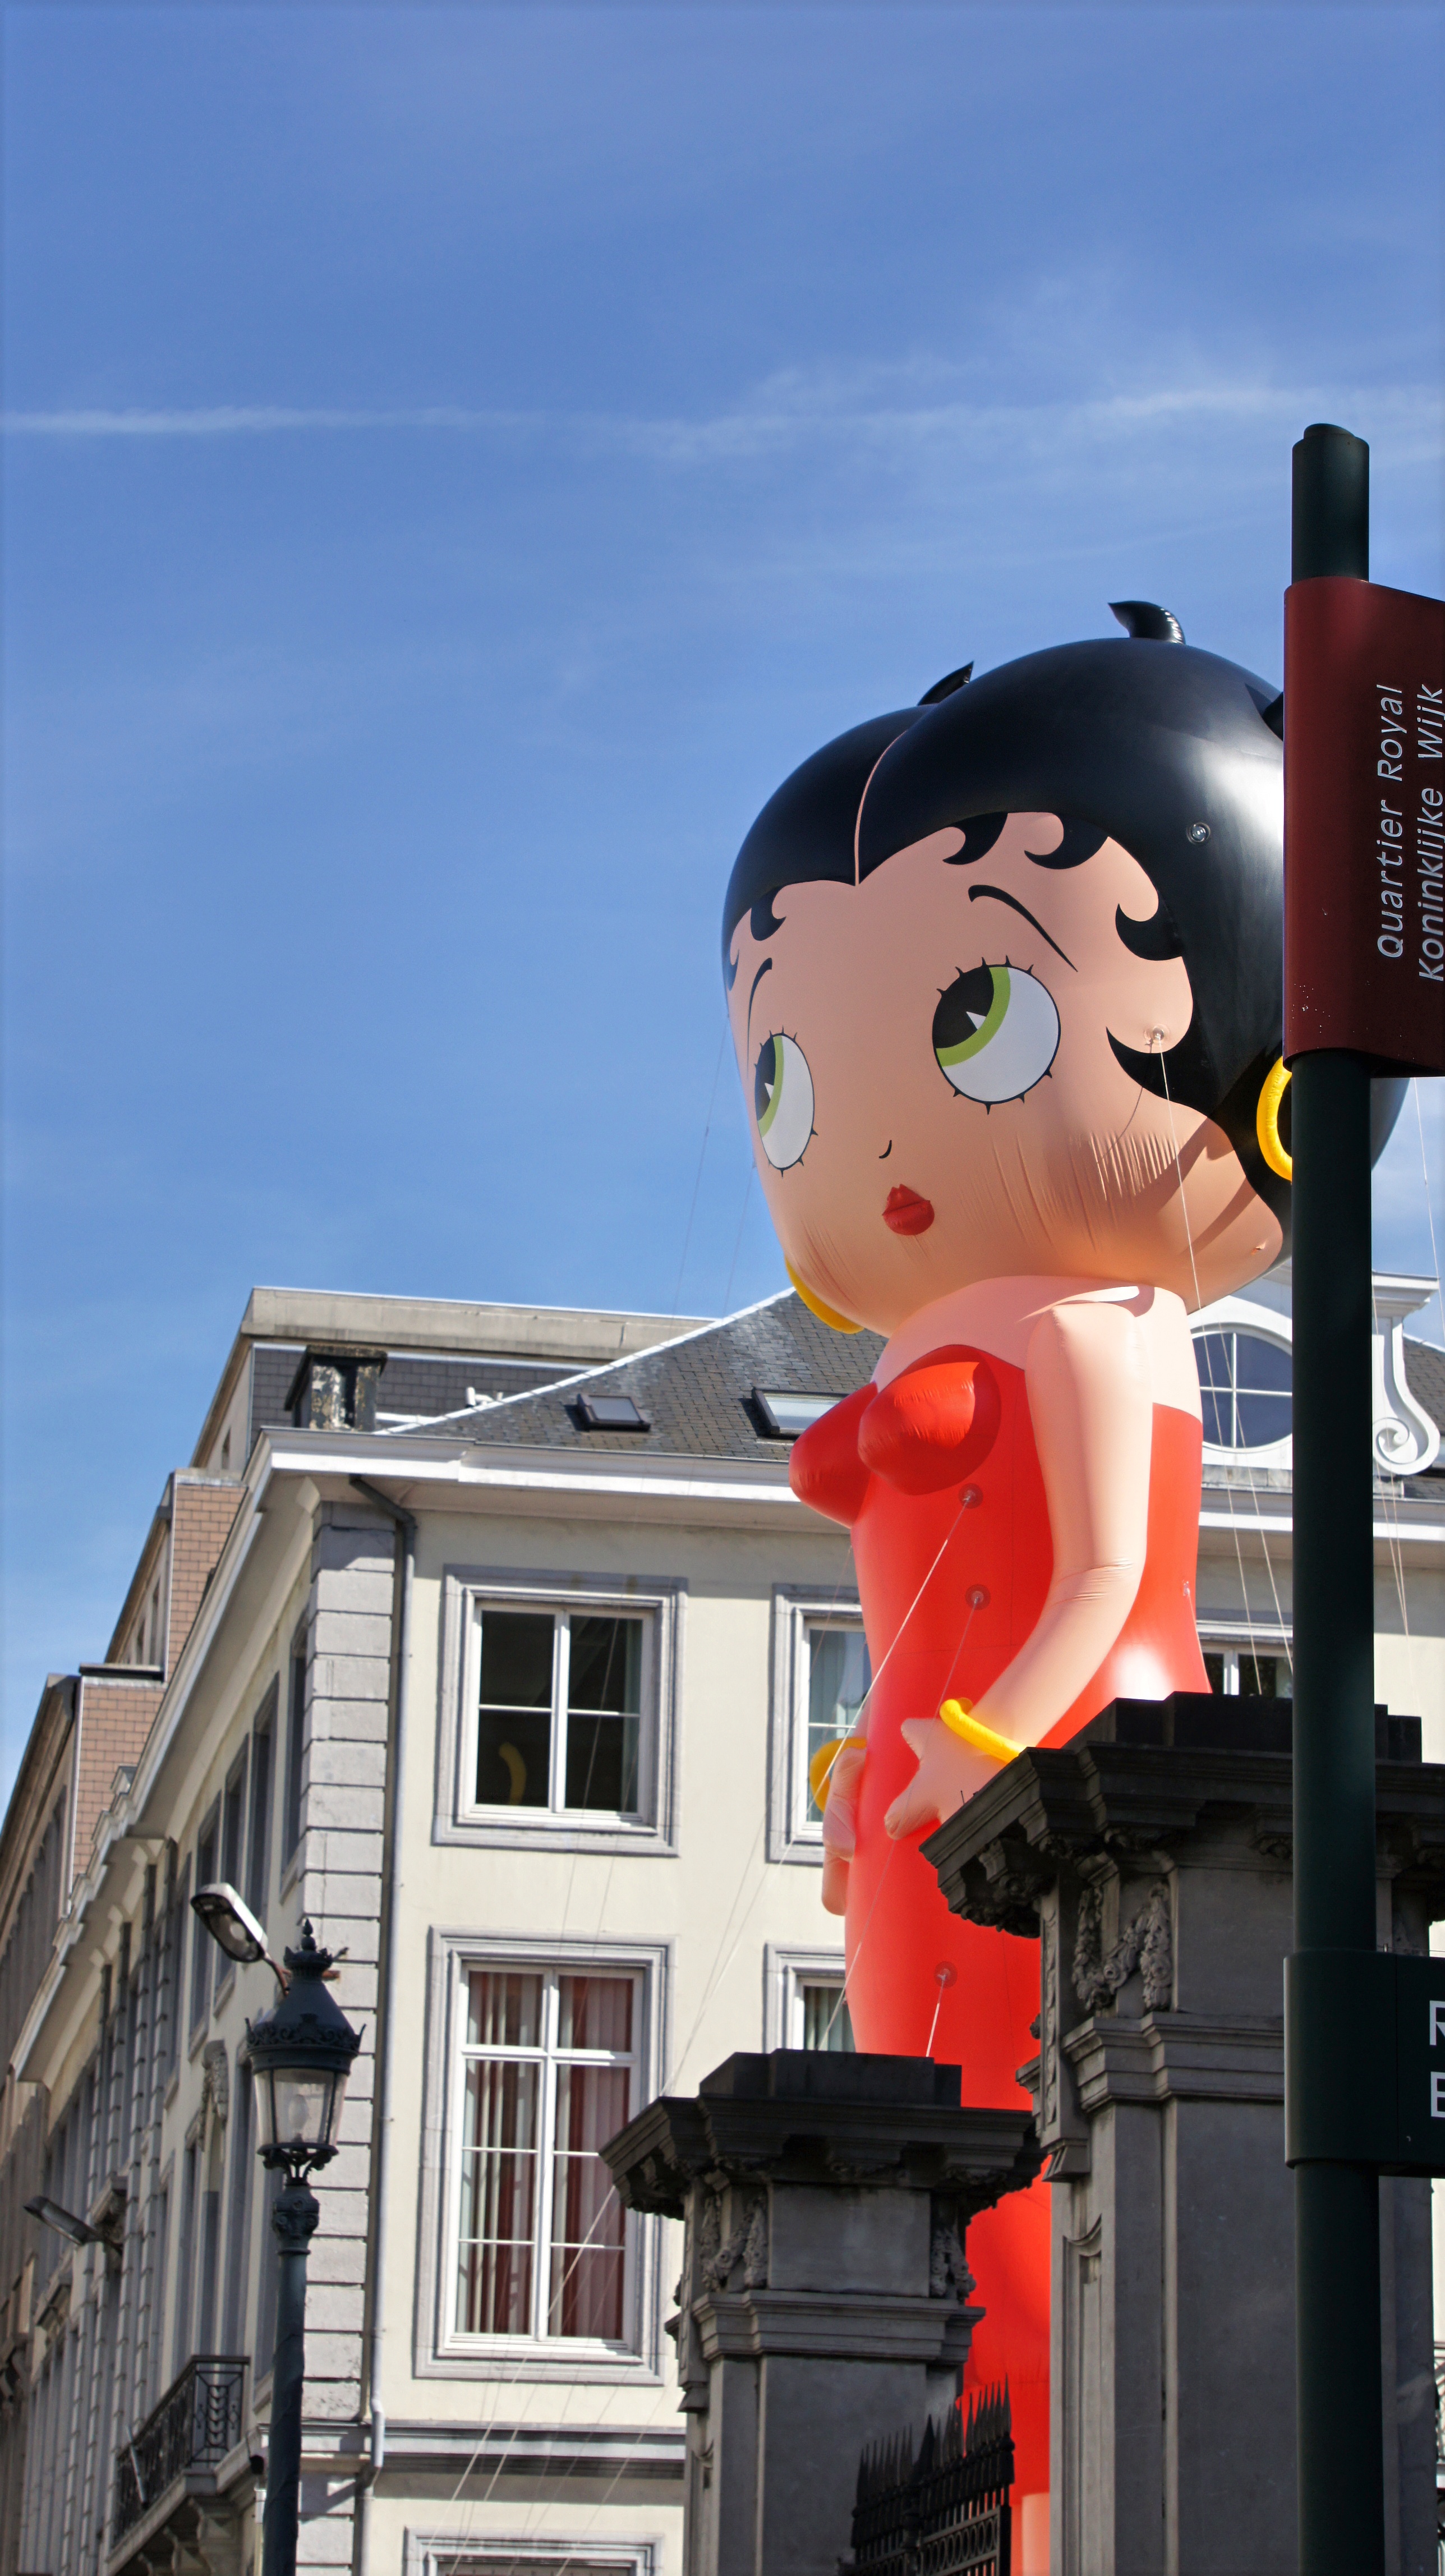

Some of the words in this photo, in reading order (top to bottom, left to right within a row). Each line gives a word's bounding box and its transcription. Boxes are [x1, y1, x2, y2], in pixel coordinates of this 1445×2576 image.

[1376, 684, 1407, 781] Royal
[1416, 684, 1445, 758] Wijk
[1376, 799, 1403, 958] Quartier
[1416, 788, 1445, 981] Koninklijke
